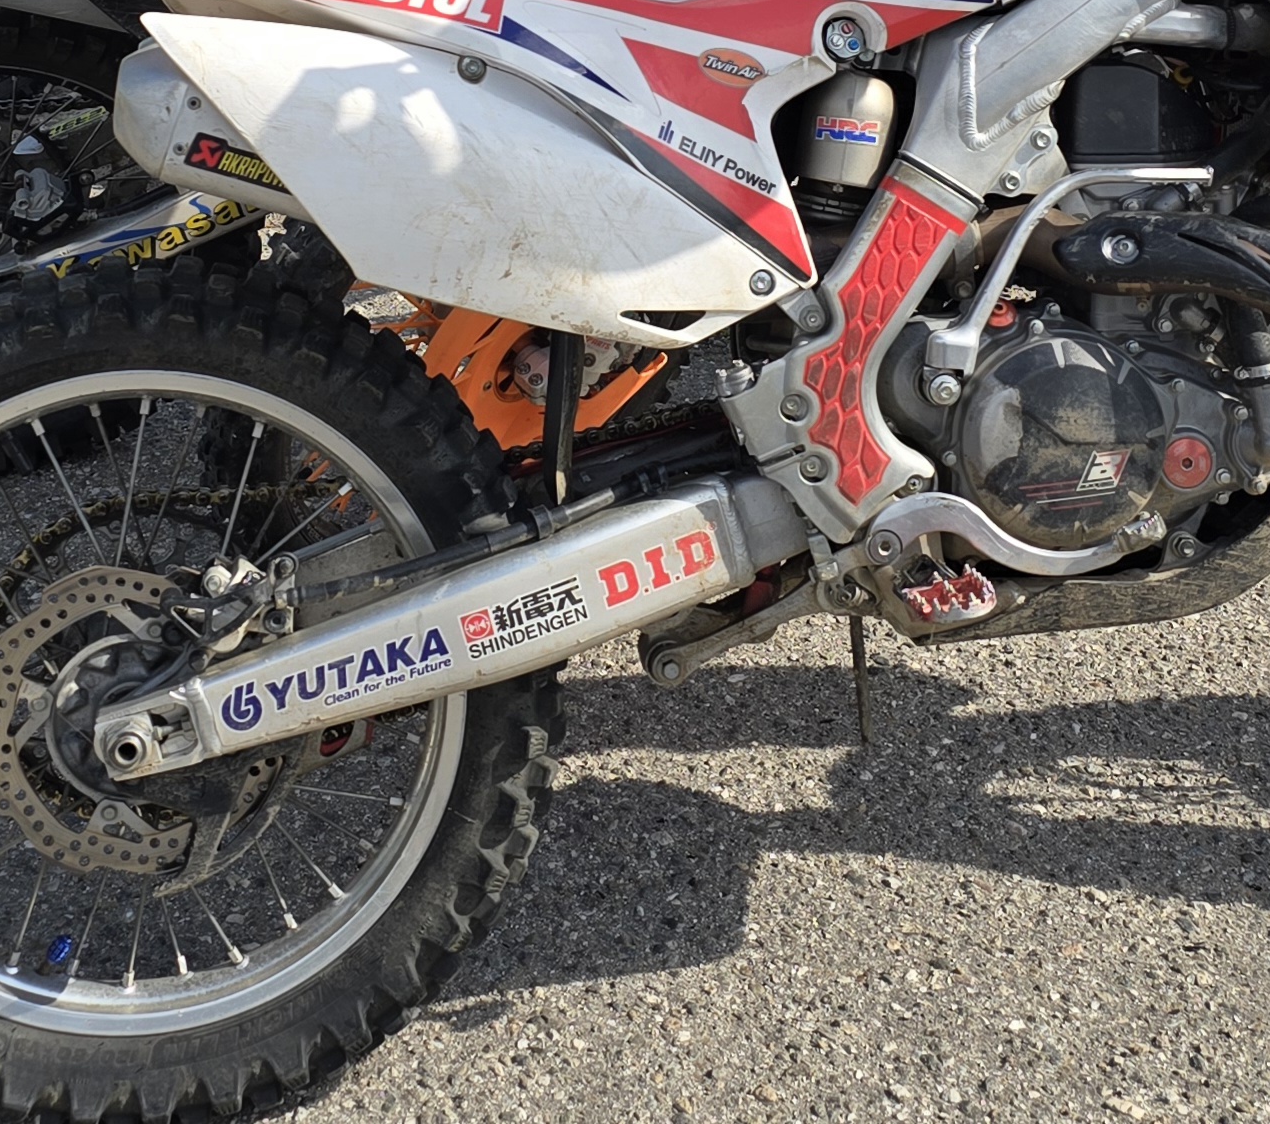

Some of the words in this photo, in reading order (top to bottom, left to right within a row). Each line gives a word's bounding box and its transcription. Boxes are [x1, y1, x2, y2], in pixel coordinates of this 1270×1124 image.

[705, 55, 739, 75] Twin
[738, 65, 762, 80] Air
[815, 115, 881, 146] HRC
[722, 157, 778, 195] Power
[599, 529, 720, 608] D.I.D
[492, 574, 587, 633] 新電元
[468, 605, 588, 661] SHINDENGEN
[266, 628, 450, 710] YUTAKA
[323, 682, 362, 707] Clean
[362, 678, 384, 697] for
[384, 673, 407, 692] the
[409, 656, 453, 683] Future
